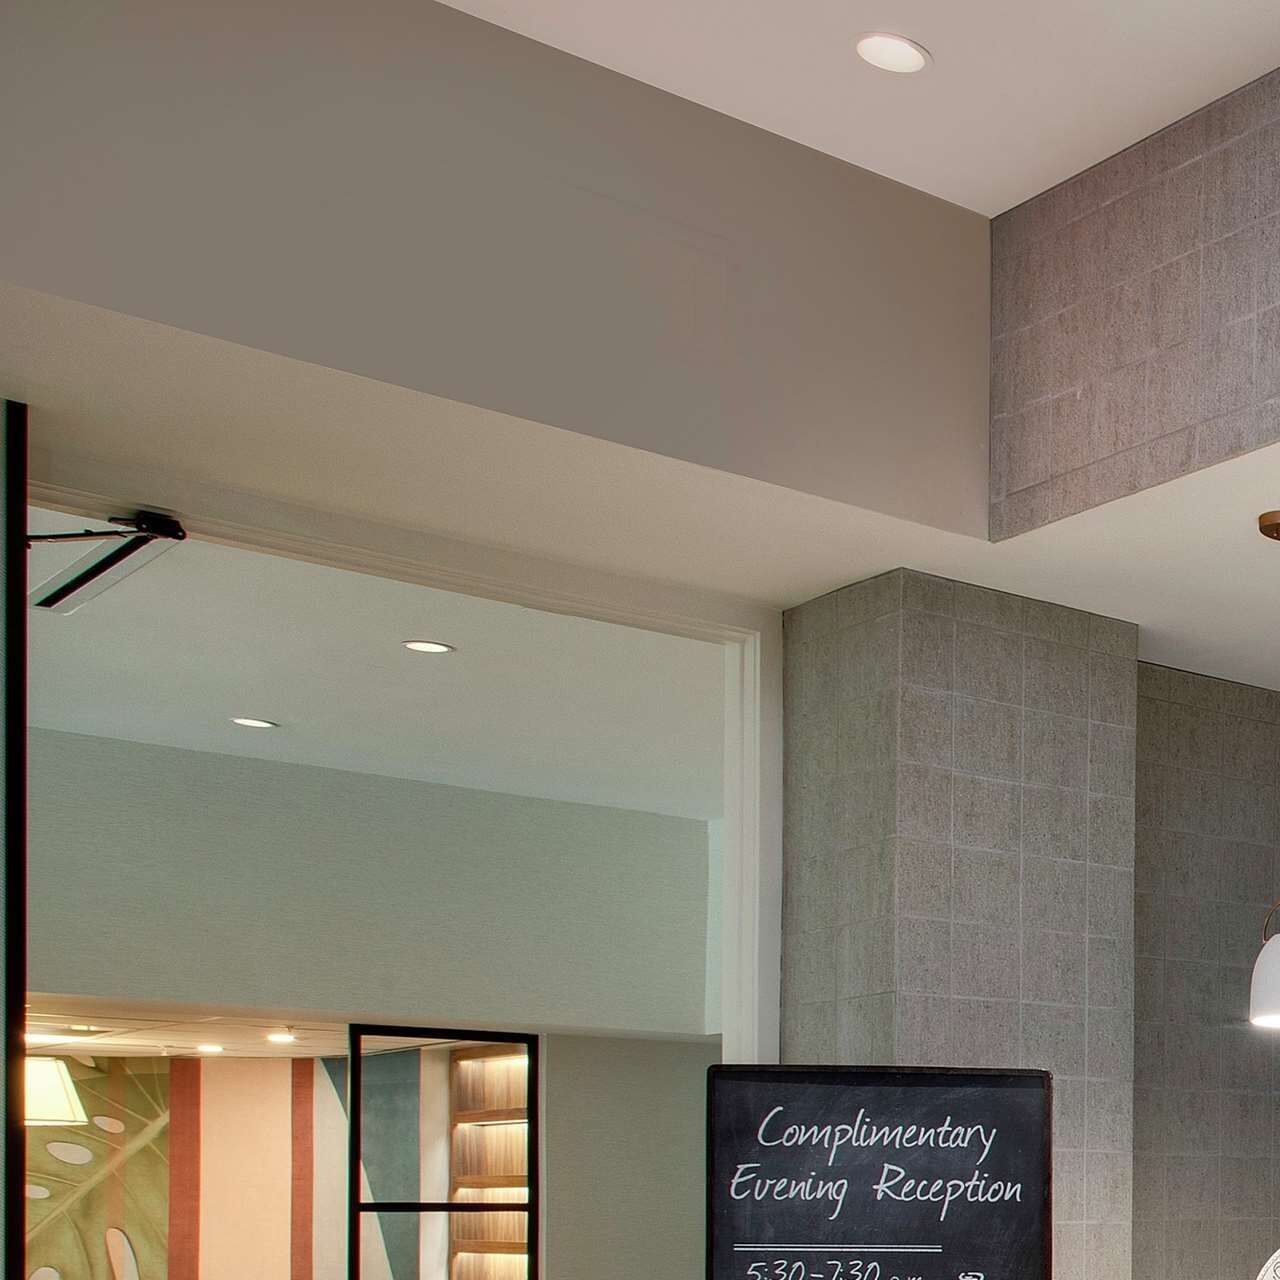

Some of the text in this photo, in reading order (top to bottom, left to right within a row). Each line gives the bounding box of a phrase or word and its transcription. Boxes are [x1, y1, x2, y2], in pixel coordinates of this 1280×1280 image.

[757, 1106, 997, 1165] Complimentary
[730, 1163, 1022, 1222] Evening Reception
